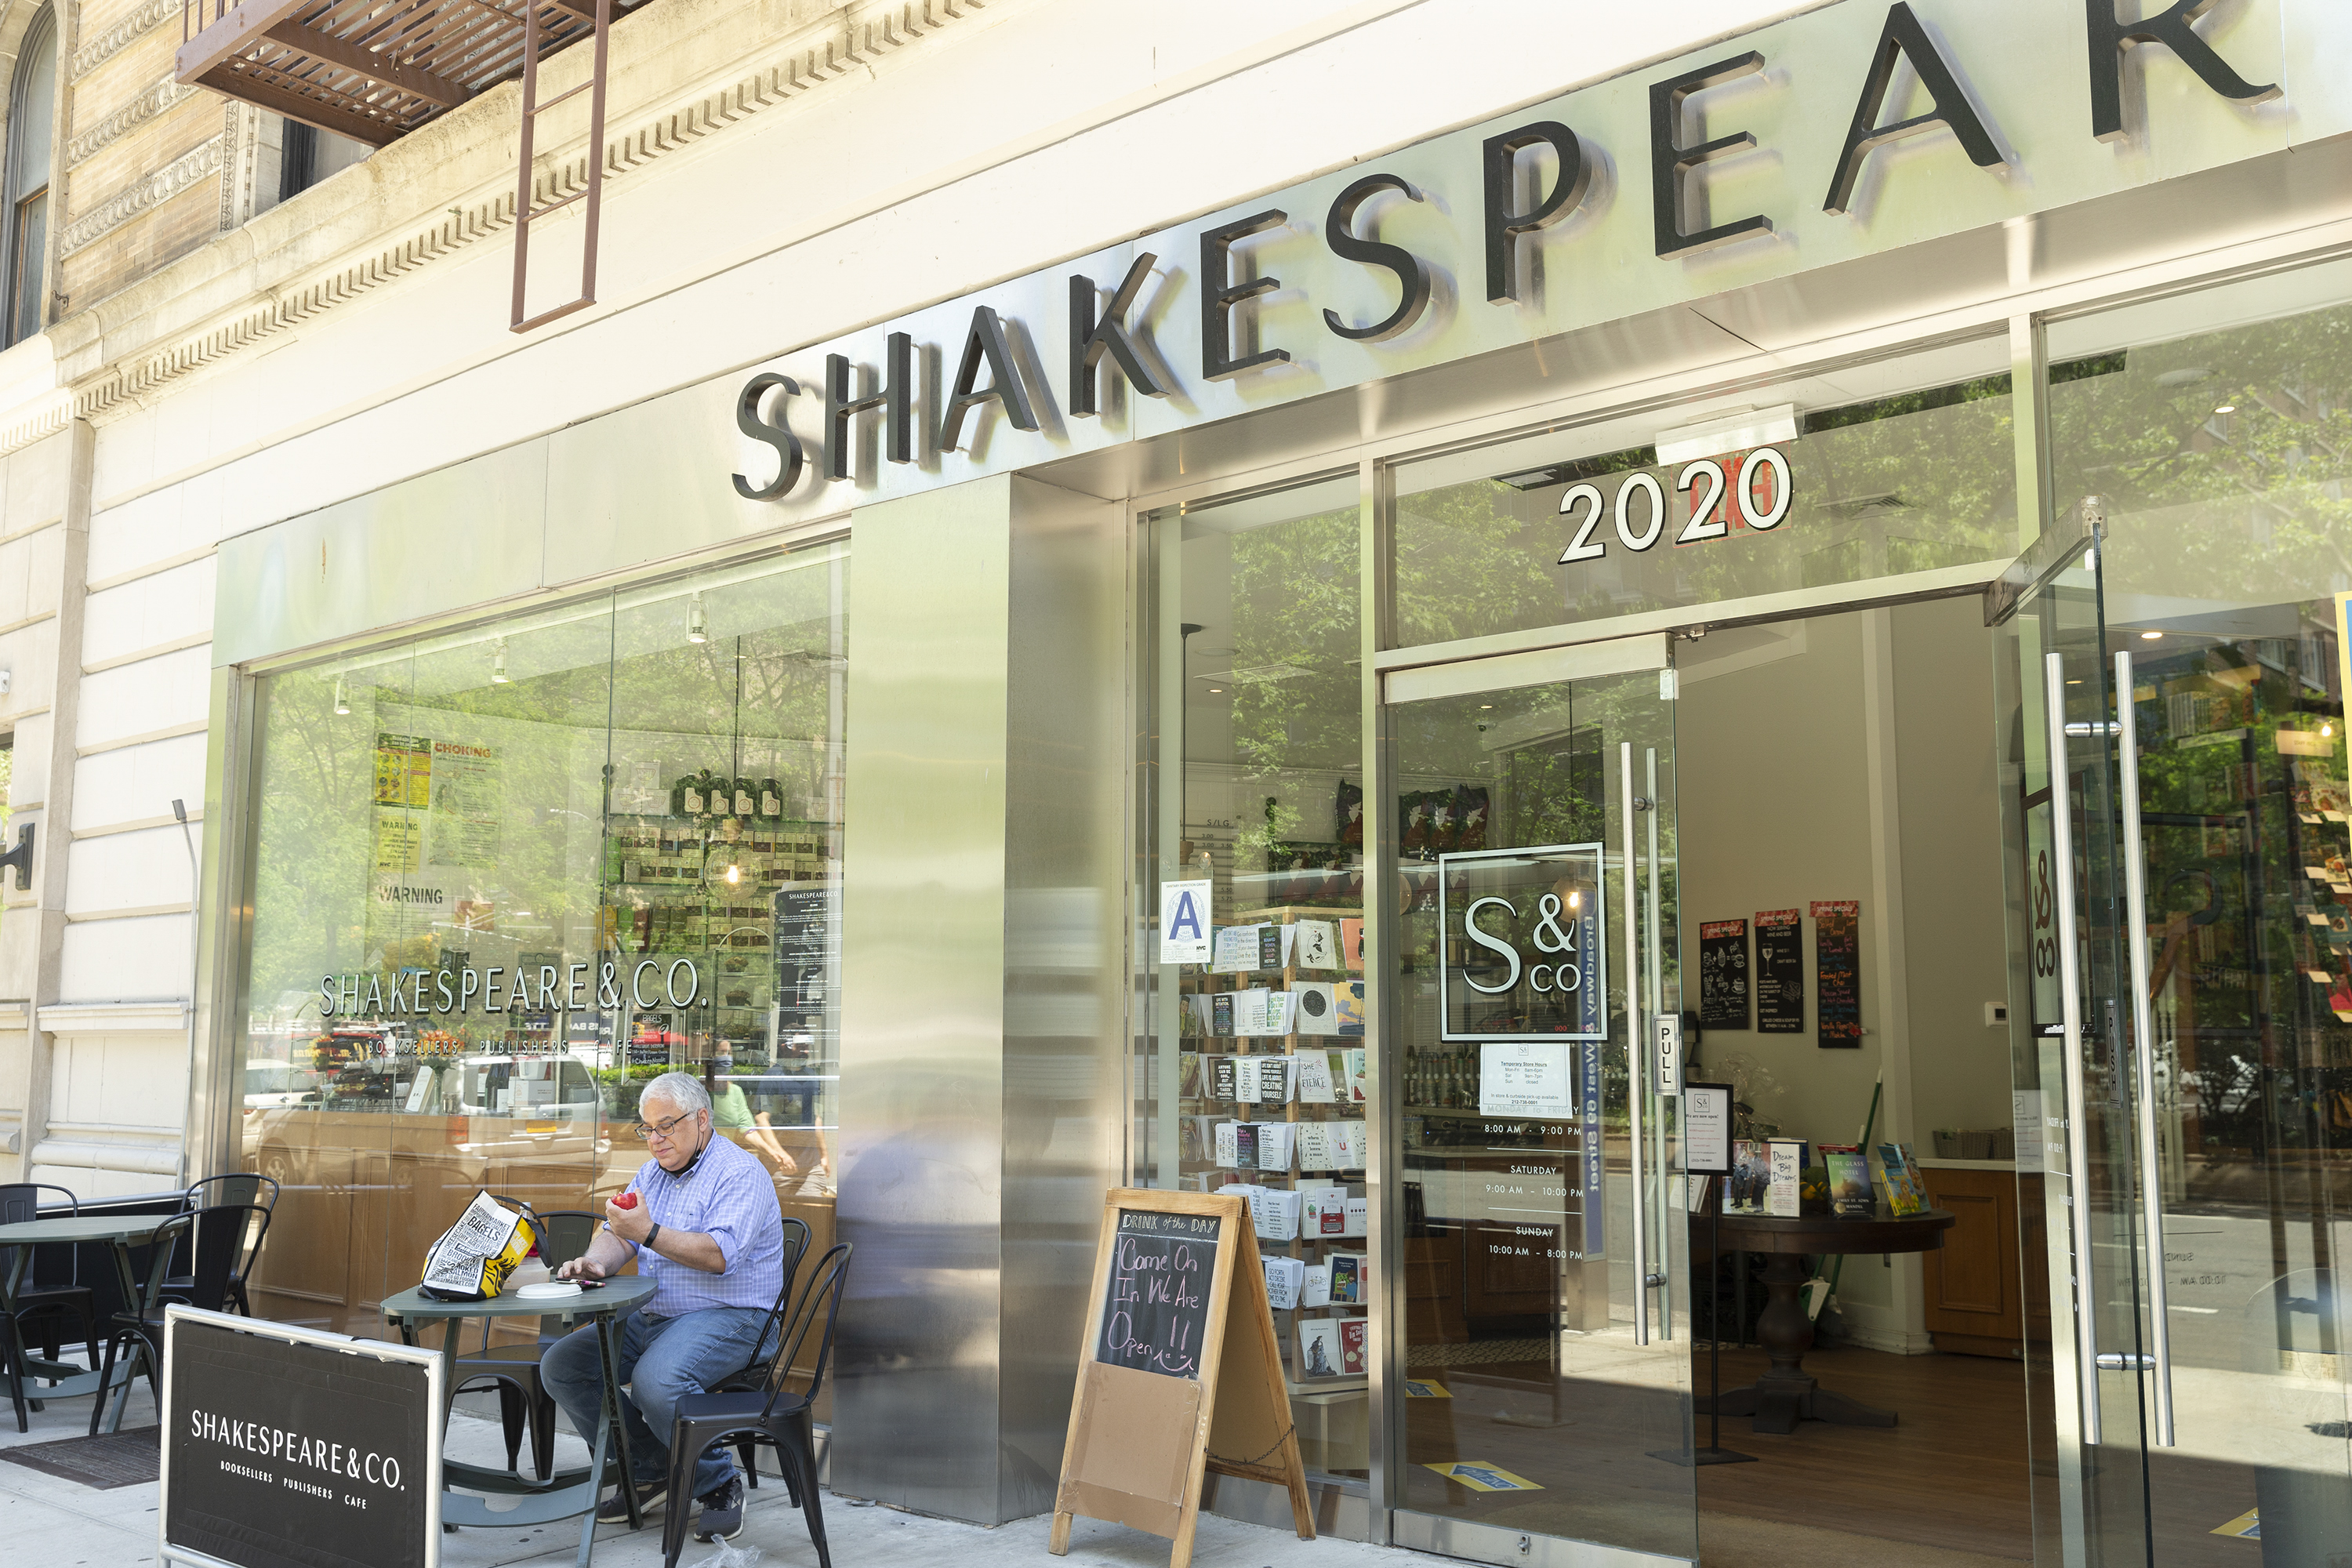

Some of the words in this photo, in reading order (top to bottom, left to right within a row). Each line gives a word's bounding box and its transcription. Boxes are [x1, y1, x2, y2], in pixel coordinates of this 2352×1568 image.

[1557, 446, 1794, 565] 2020
[434, 742, 492, 758] CHOKING
[382, 821, 418, 831] WARNNG
[379, 886, 443, 905] WARNING
[1169, 891, 1203, 940] A
[319, 958, 708, 1016] SHAKESPEARE&CO.
[643, 1014, 662, 1023] BAGELS
[368, 1040, 459, 1055] BOOKSELLERS
[479, 1040, 568, 1055] PUBLISHERS
[593, 1040, 633, 1055] CAFE
[2108, 1017, 2117, 1091] PUSH
[1661, 1028, 1671, 1083] PULL
[1261, 1082, 1283, 1091] CREATING
[1302, 1077, 1327, 1088] FIERCE
[1261, 1091, 1283, 1099] YOURSELF.
[1486, 1105, 1526, 1113] MONDAY
[1548, 1106, 1579, 1115] FRIDAY
[1485, 1124, 1504, 1133] 8:00
[1506, 1125, 1521, 1134] AM
[1541, 1126, 1563, 1135] 9:00
[1567, 1127, 1582, 1136] PM
[1773, 1151, 1796, 1162] Dream
[1510, 1165, 1556, 1175] SATURDAY
[1777, 1163, 1791, 1173] Big
[1773, 1171, 1797, 1182] Dreams
[1508, 1185, 1523, 1194] AM
[1542, 1187, 1566, 1196] 10:00
[1570, 1189, 1584, 1197] PM
[467, 1215, 501, 1242] BAGELS
[1123, 1214, 1159, 1230] DRINK
[1163, 1218, 1173, 1231] of
[1171, 1217, 1186, 1230] the
[1191, 1218, 1217, 1233] DAY
[444, 1220, 467, 1250] CHEESECAKE
[1515, 1226, 1554, 1237] SUNDAY
[459, 1232, 480, 1249] DRY-AGED
[1120, 1238, 1168, 1271] Come
[1174, 1245, 1198, 1272] On
[1489, 1244, 1512, 1254] 10:00
[1515, 1247, 1529, 1255] AM
[1547, 1249, 1566, 1258] 8:00
[1570, 1250, 1583, 1259] PM
[448, 1268, 478, 1280] SALMON
[1113, 1277, 1140, 1303] In
[1148, 1275, 1171, 1305] We
[1174, 1275, 1200, 1309] Are
[1108, 1310, 1152, 1358] Open
[191, 1409, 405, 1491] SHAKESPEARE&CO.
[220, 1460, 273, 1483] BOOKSELLERS
[284, 1477, 333, 1500] PUBLISHERS
[345, 1494, 367, 1509] CAFE
